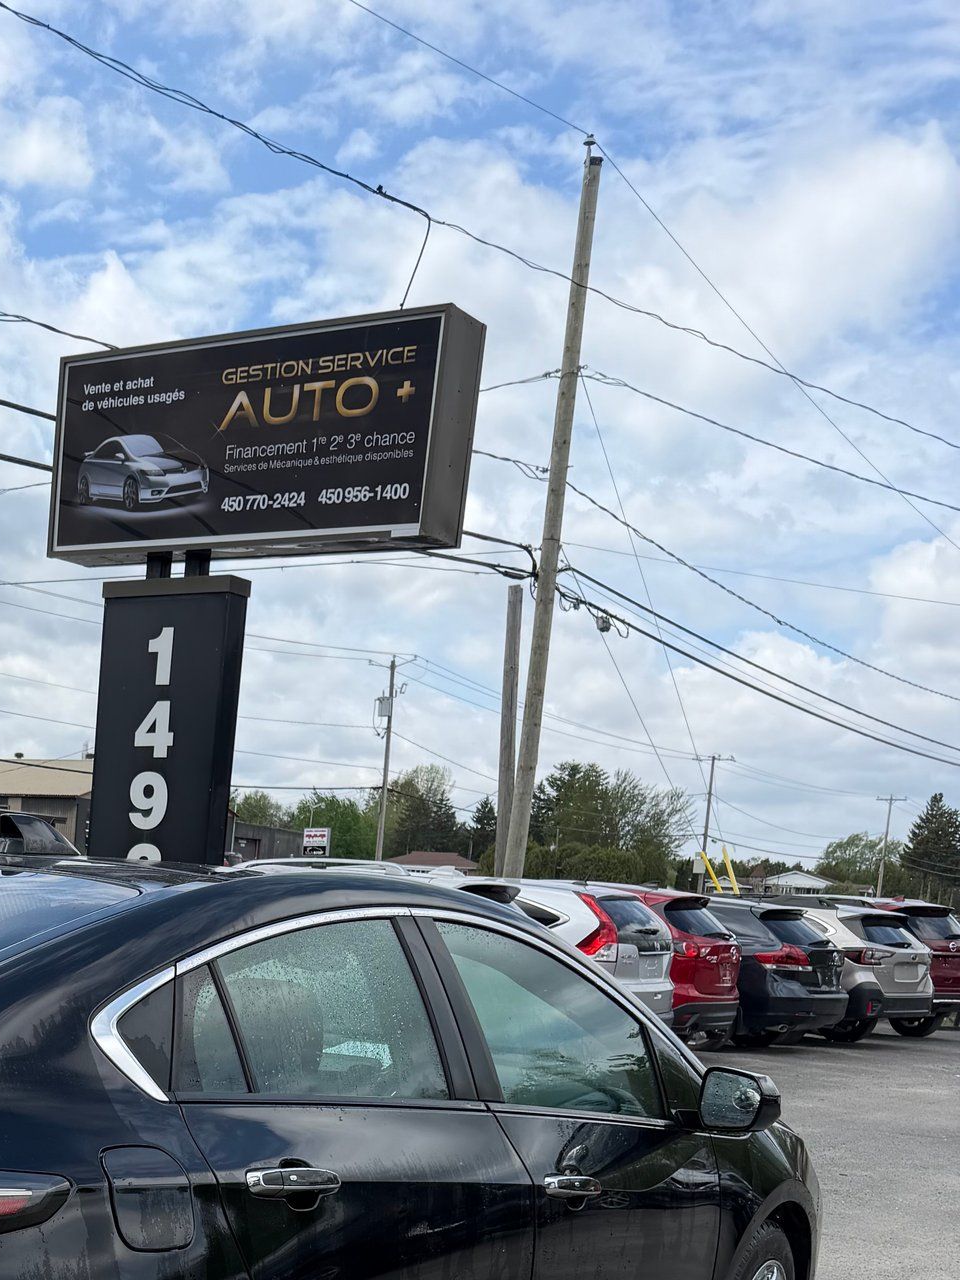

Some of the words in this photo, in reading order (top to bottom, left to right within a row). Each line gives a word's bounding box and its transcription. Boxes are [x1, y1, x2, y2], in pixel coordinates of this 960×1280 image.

[222, 358, 312, 385] GESTION
[318, 345, 417, 374] SERVICE
[83, 382, 111, 395] Vente
[113, 380, 123, 391] et
[125, 376, 154, 390] achat
[82, 400, 95, 411] de
[97, 394, 145, 410] véhicules
[147, 388, 185, 404] usagés
[218, 375, 380, 432] AUTO
[396, 379, 416, 404] +
[225, 439, 307, 460] Financement
[364, 431, 415, 447] chance
[224, 463, 257, 473] Services
[257, 461, 268, 470] de
[268, 459, 313, 469] Mécanique
[313, 456, 320, 465] &
[320, 453, 363, 464] esthétique
[364, 448, 414, 461] disponibles
[220, 496, 244, 512] 450
[245, 491, 306, 511] 770-2424
[318, 488, 344, 504] 450
[344, 483, 410, 503] 956-1400
[126, 627, 175, 862] 149
